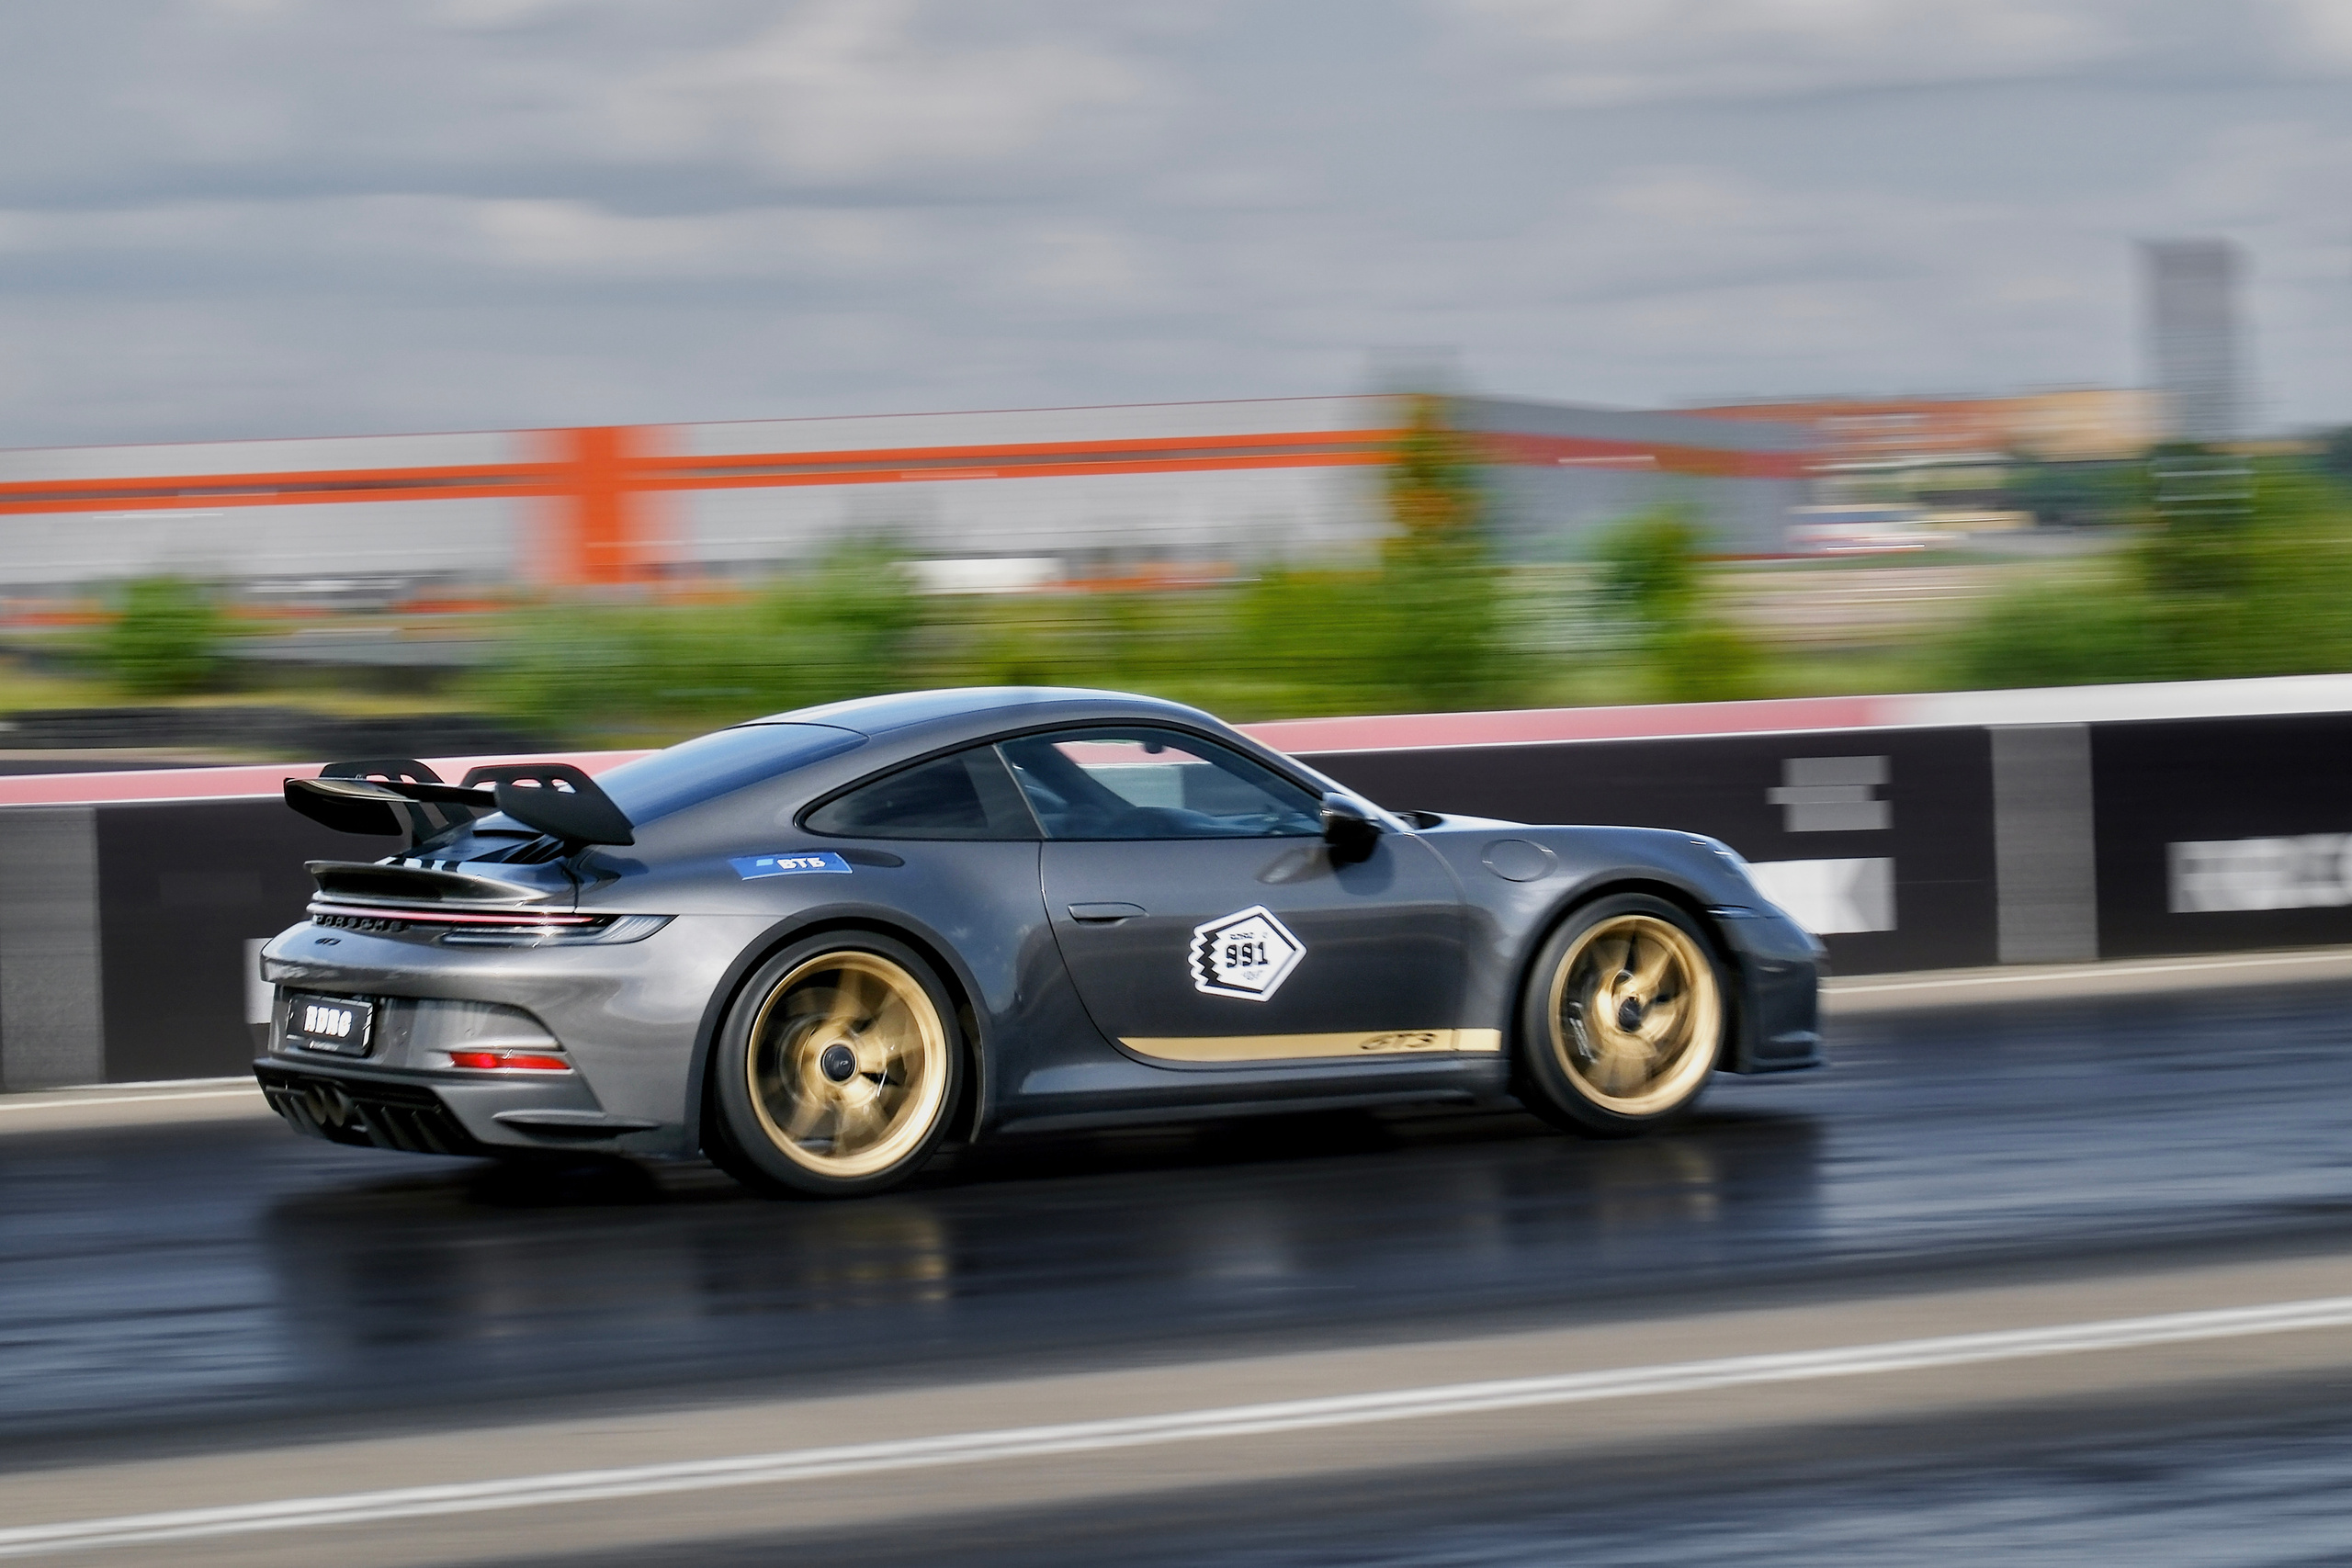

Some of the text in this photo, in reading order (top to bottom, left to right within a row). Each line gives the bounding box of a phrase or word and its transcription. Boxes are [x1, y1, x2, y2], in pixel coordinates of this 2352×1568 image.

[776, 857, 826, 869] ВТБ
[313, 914, 403, 932] PORSCHE
[1226, 942, 1269, 968] 991
[1361, 1032, 1436, 1050] GT3
